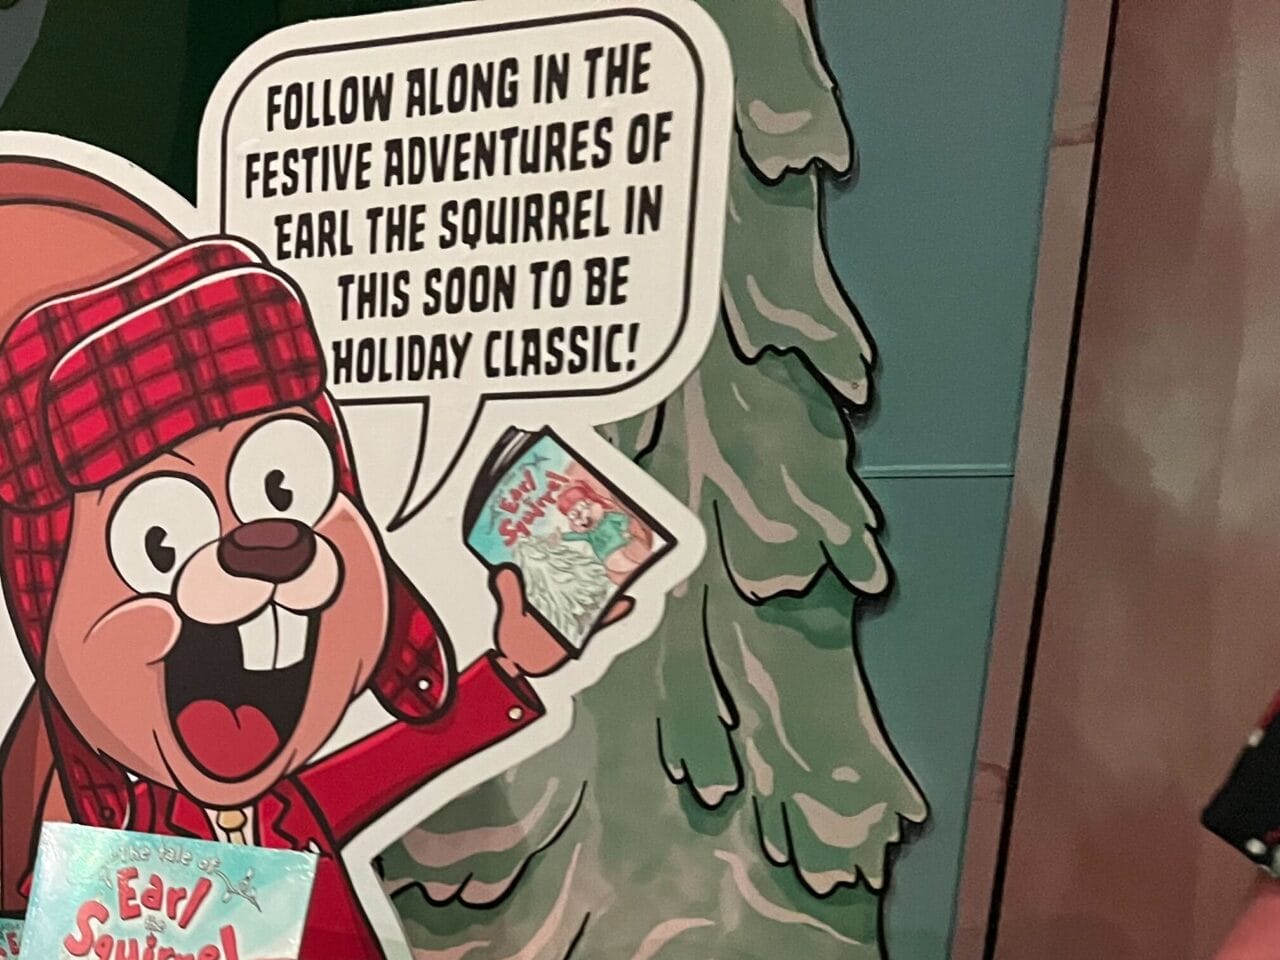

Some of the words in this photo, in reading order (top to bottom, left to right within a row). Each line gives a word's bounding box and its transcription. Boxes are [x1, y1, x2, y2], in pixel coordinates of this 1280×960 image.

[266, 73, 394, 131] FOLLOW
[406, 57, 519, 118] ALONG
[533, 52, 570, 104] IN
[584, 42, 652, 98] THE
[245, 142, 372, 199] FESTIVE
[384, 116, 613, 187] ADVENTURES
[627, 111, 673, 164] OF
[274, 209, 353, 260] EARL
[366, 204, 425, 254] THE
[439, 190, 610, 250] SQUIRREL
[624, 184, 663, 236] IN
[338, 269, 409, 321] THIS
[423, 265, 516, 316] SOON
[529, 260, 572, 310] TO
[585, 256, 630, 306] BE
[331, 332, 473, 385] HOLIDAY
[484, 322, 640, 378] CLASSIC!
[117, 866, 212, 929] Earl
